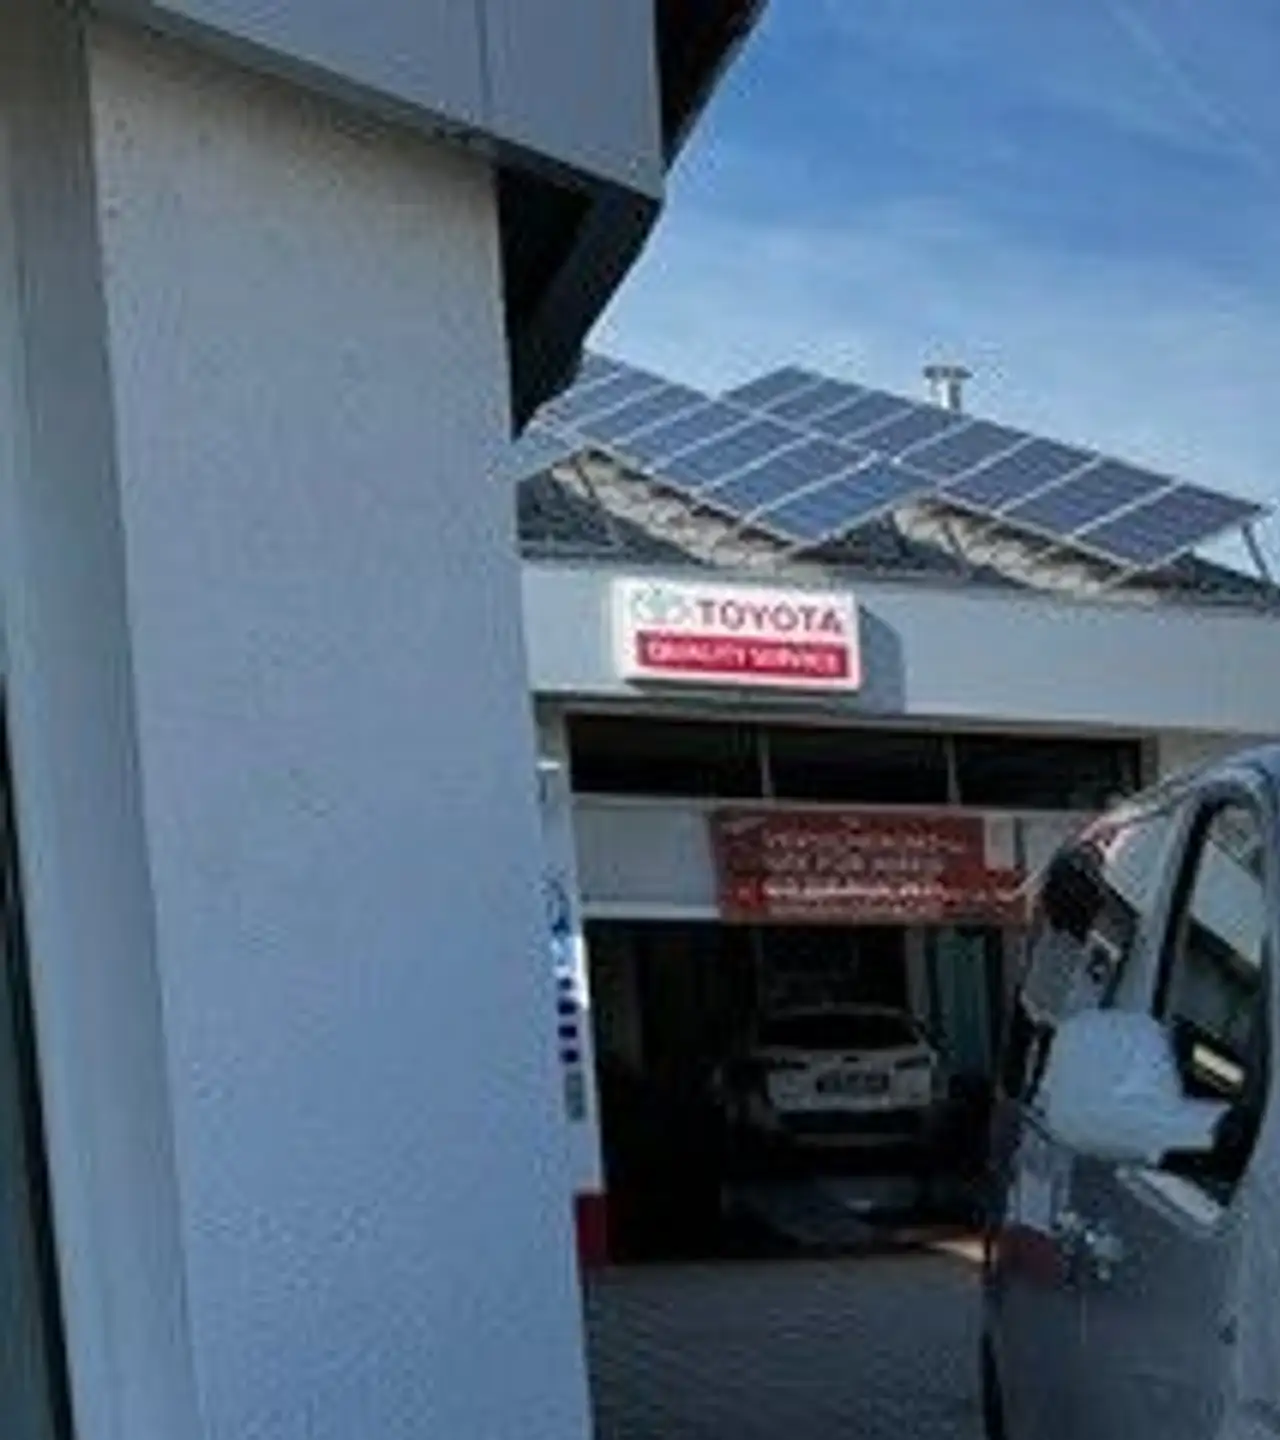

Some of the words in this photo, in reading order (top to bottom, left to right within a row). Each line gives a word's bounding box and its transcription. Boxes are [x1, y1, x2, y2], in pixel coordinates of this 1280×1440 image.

[696, 599, 843, 634] TOYOTA
[647, 638, 746, 669] QUALITY
[750, 645, 840, 675] SERVICE
